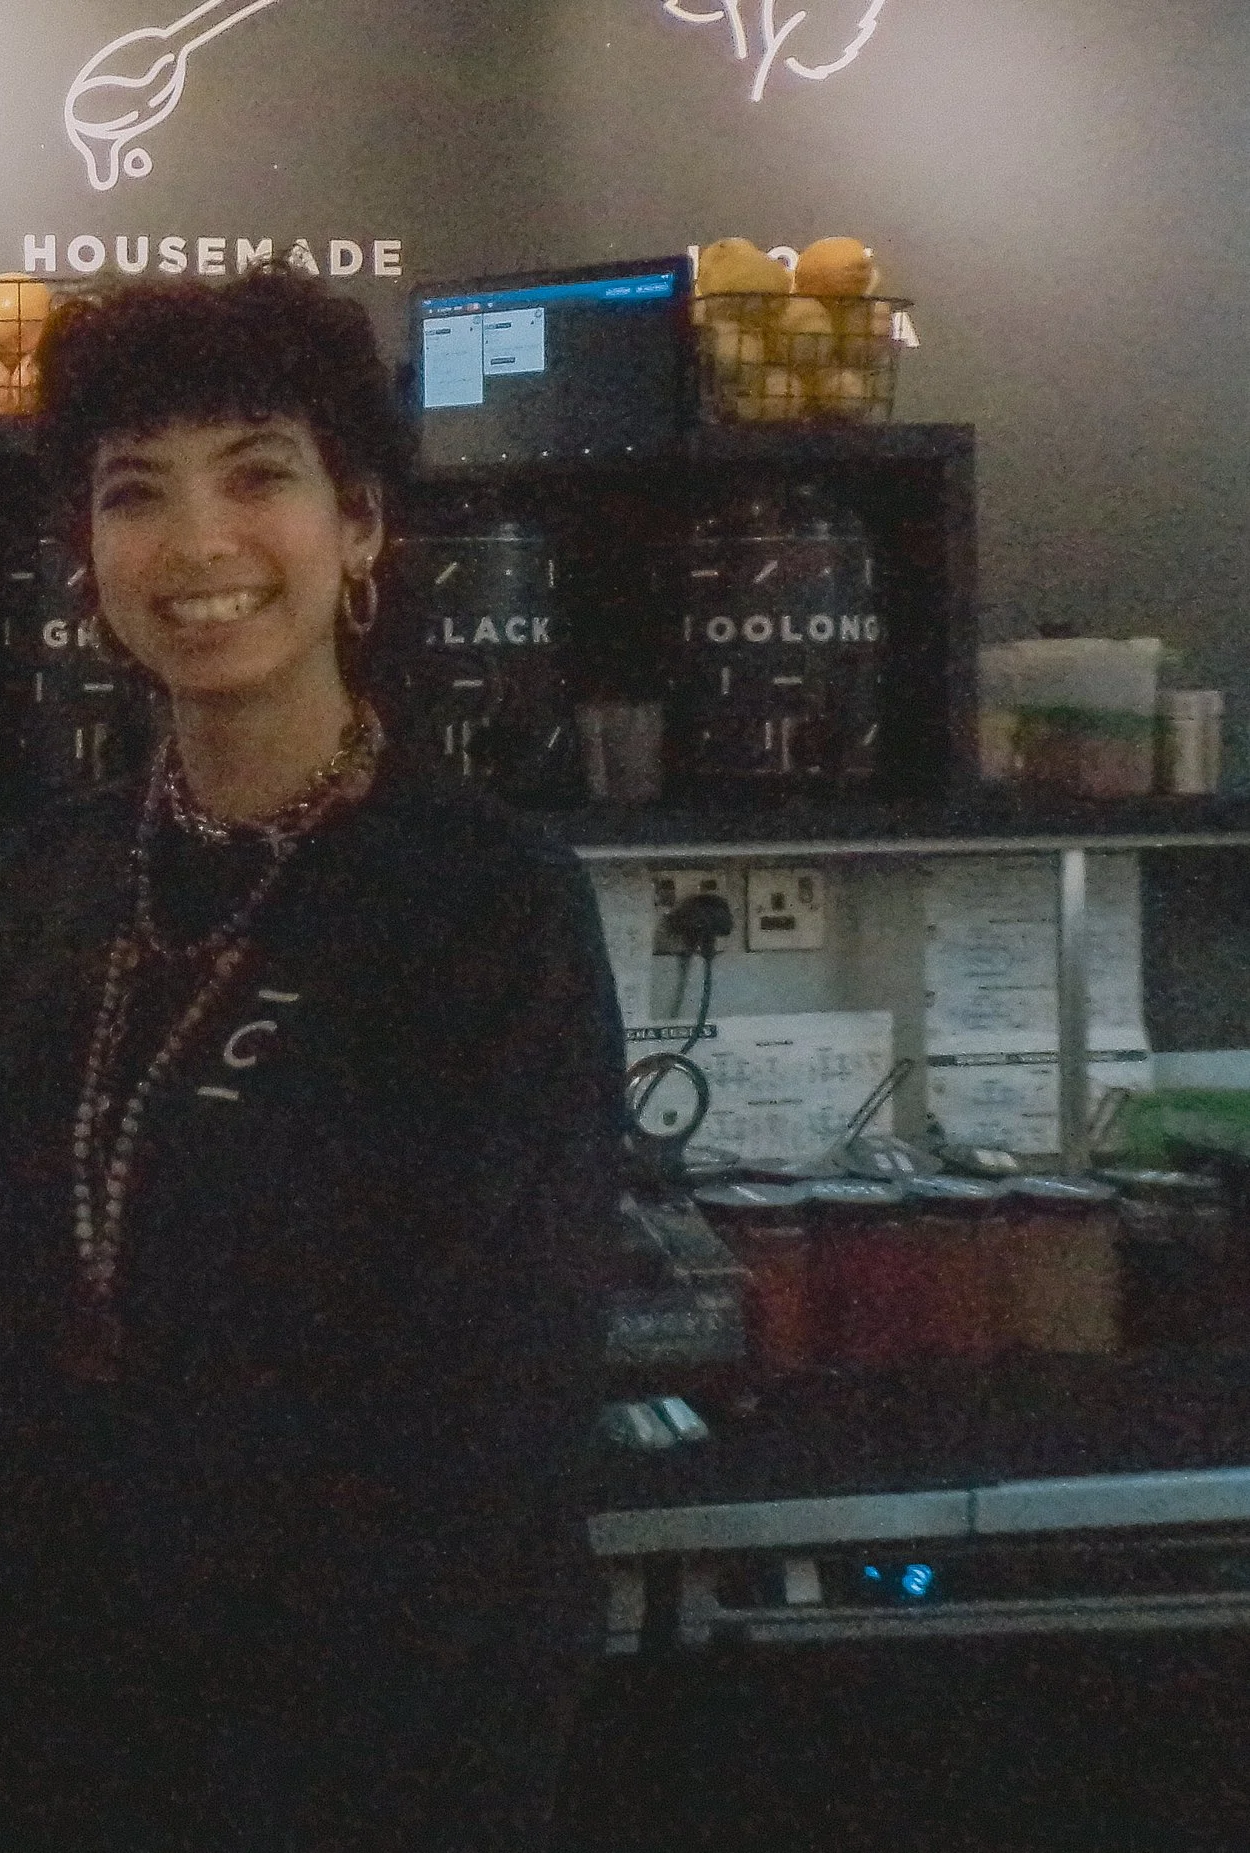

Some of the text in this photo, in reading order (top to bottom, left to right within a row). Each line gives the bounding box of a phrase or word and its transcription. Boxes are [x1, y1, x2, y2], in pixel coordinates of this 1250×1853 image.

[23, 234, 402, 276] HOUSEMADE
[426, 615, 551, 645] LACK
[706, 614, 880, 643] OOLONG
